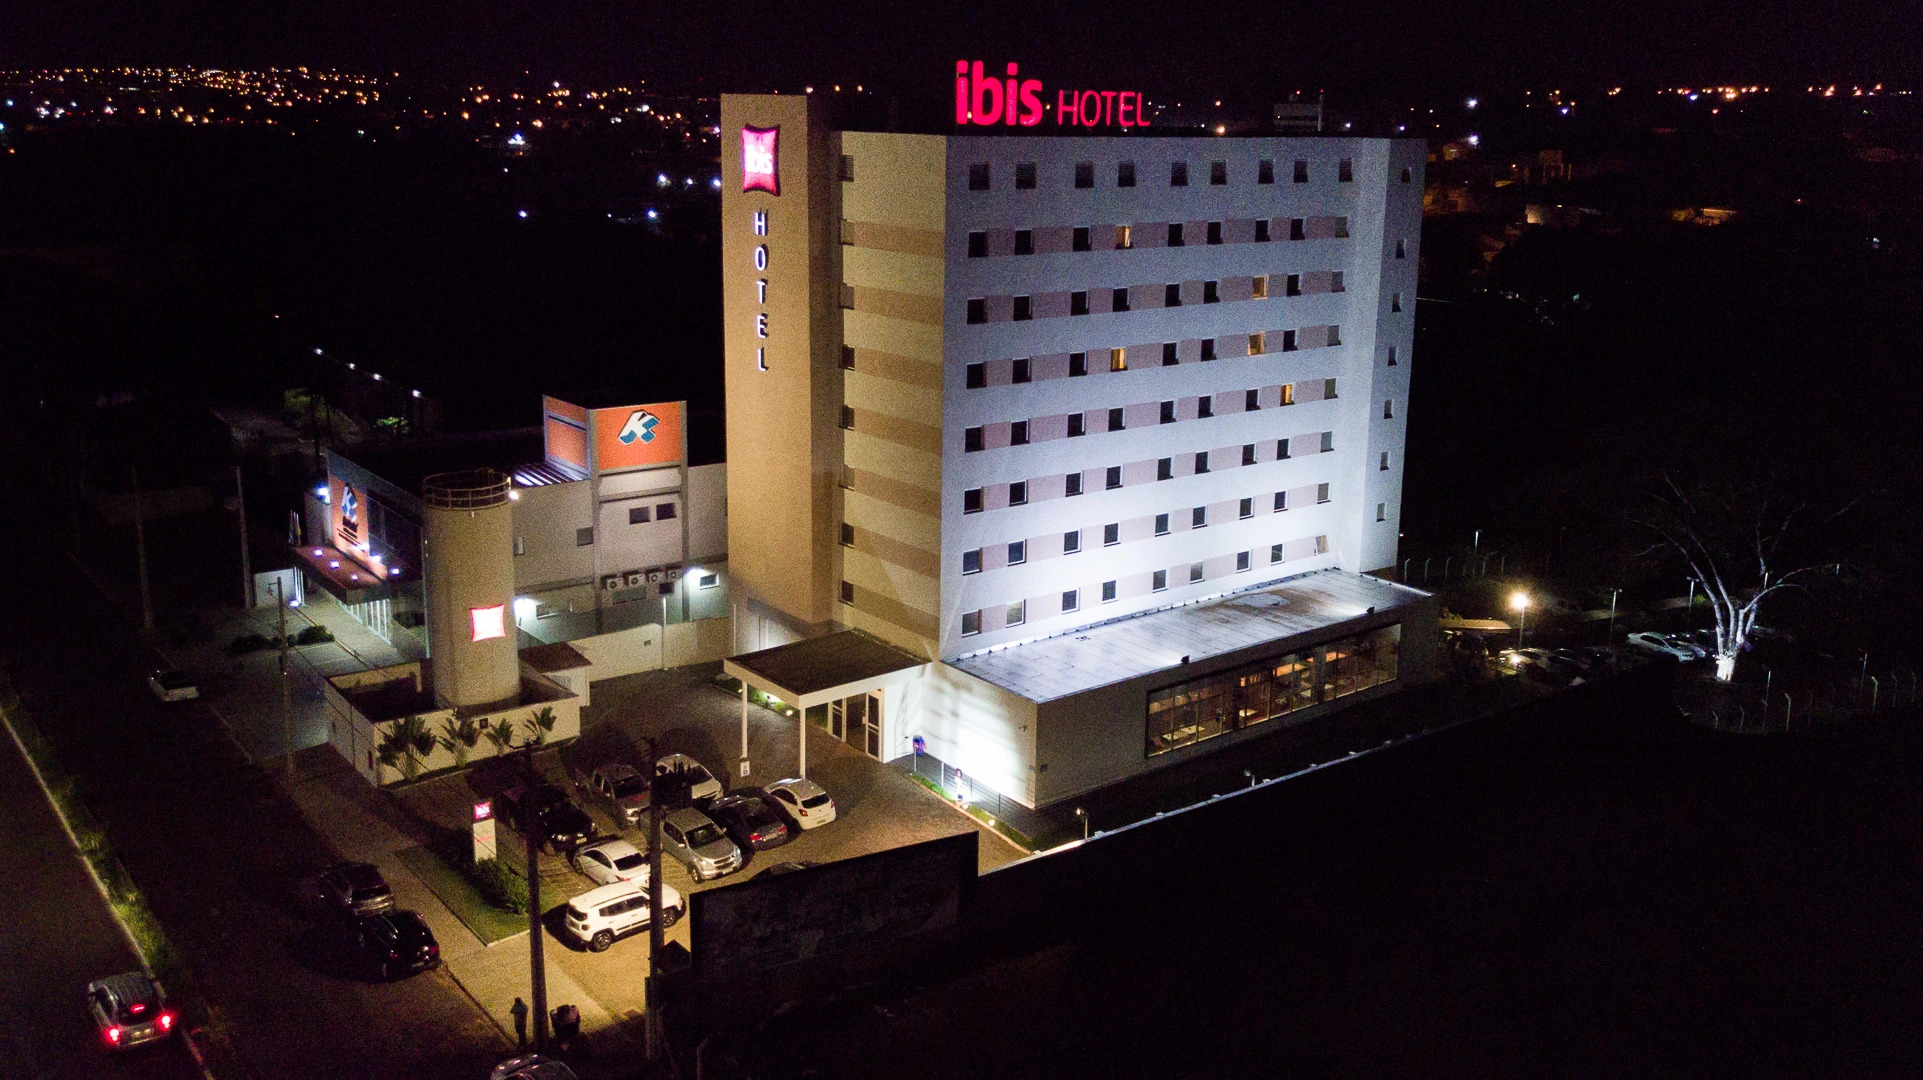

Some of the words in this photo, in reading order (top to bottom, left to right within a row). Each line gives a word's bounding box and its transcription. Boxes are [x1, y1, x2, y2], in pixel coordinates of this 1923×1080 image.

[956, 60, 1043, 126] ibis
[1057, 89, 1150, 127] HOTEL
[745, 144, 772, 175] ibis
[754, 210, 768, 372] HOTEL
